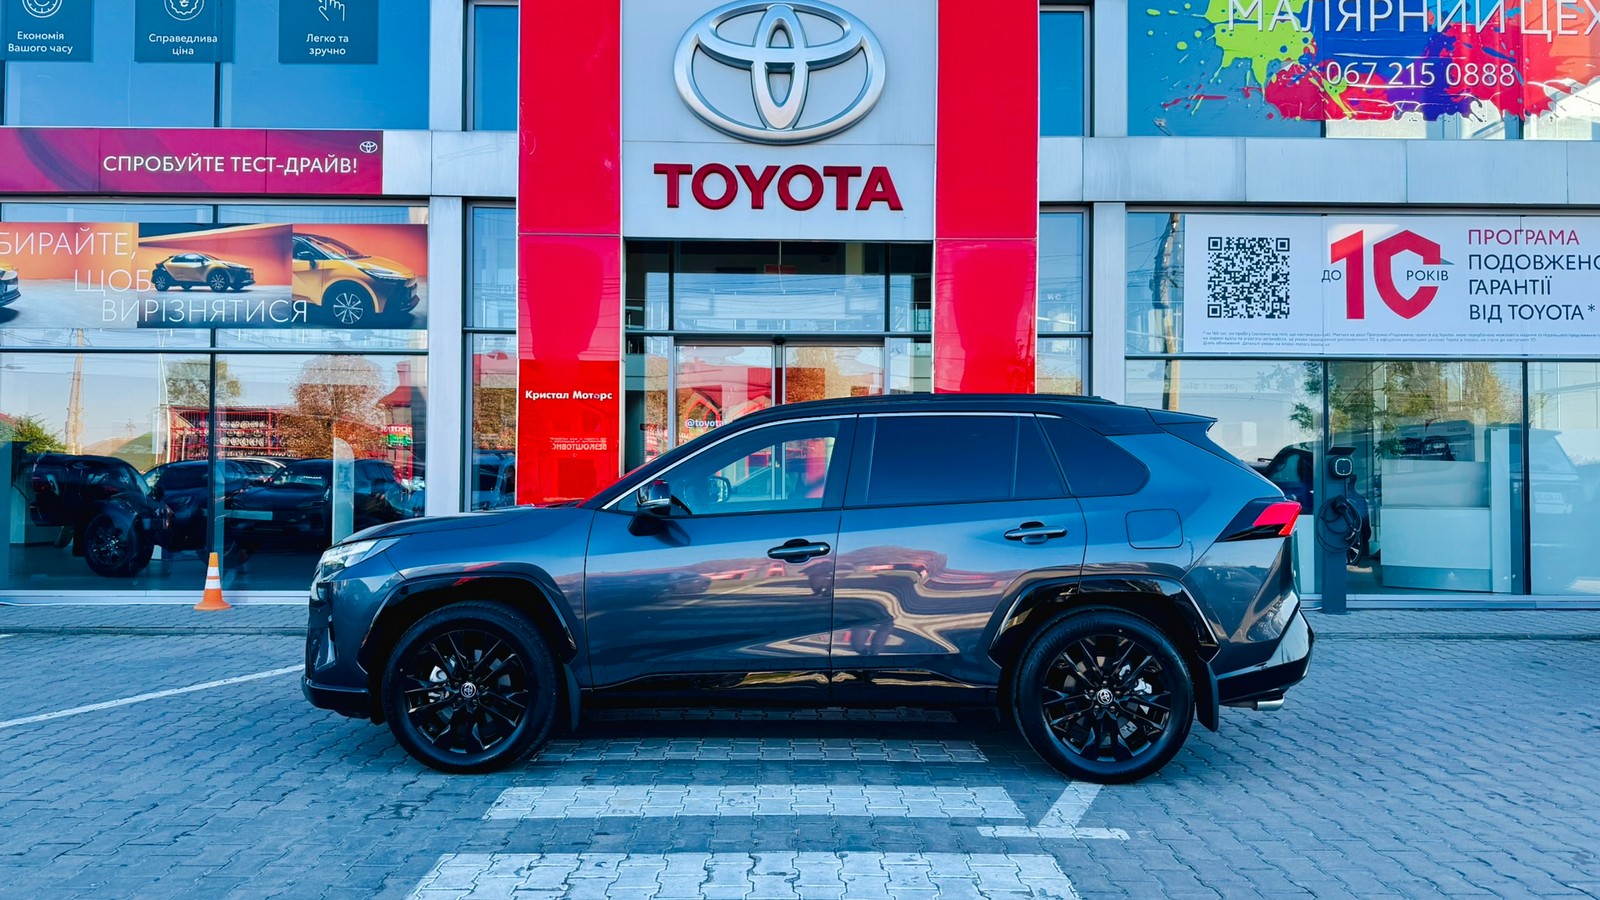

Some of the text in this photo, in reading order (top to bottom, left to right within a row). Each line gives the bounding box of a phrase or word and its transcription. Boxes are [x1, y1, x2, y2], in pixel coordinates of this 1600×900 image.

[17, 31, 65, 40] Економія
[148, 33, 218, 44] Справедлива
[306, 33, 349, 43] Легко та
[8, 43, 73, 54] Вашого часу
[172, 46, 194, 56] ціна
[309, 47, 346, 56] зручно
[1326, 61, 1515, 87] 067 215 0888
[103, 153, 358, 176] СПРОБУЙТЕ ТЕСТ-ДРАЙВ!
[653, 163, 904, 211] TOYOTA
[1468, 229, 1580, 245] ПРОГРАМА
[74, 269, 153, 296] ЩОБ
[1321, 270, 1342, 283] ДО
[1406, 270, 1449, 281] РОКІВ
[1468, 275, 1553, 295] ГАРАНТІЇ
[102, 299, 308, 323] ВИРІЗНЯТИСЯ
[1469, 304, 1503, 323] ВІД
[525, 390, 613, 401] Кристал Моторс
[684, 418, 728, 429] @toyota
